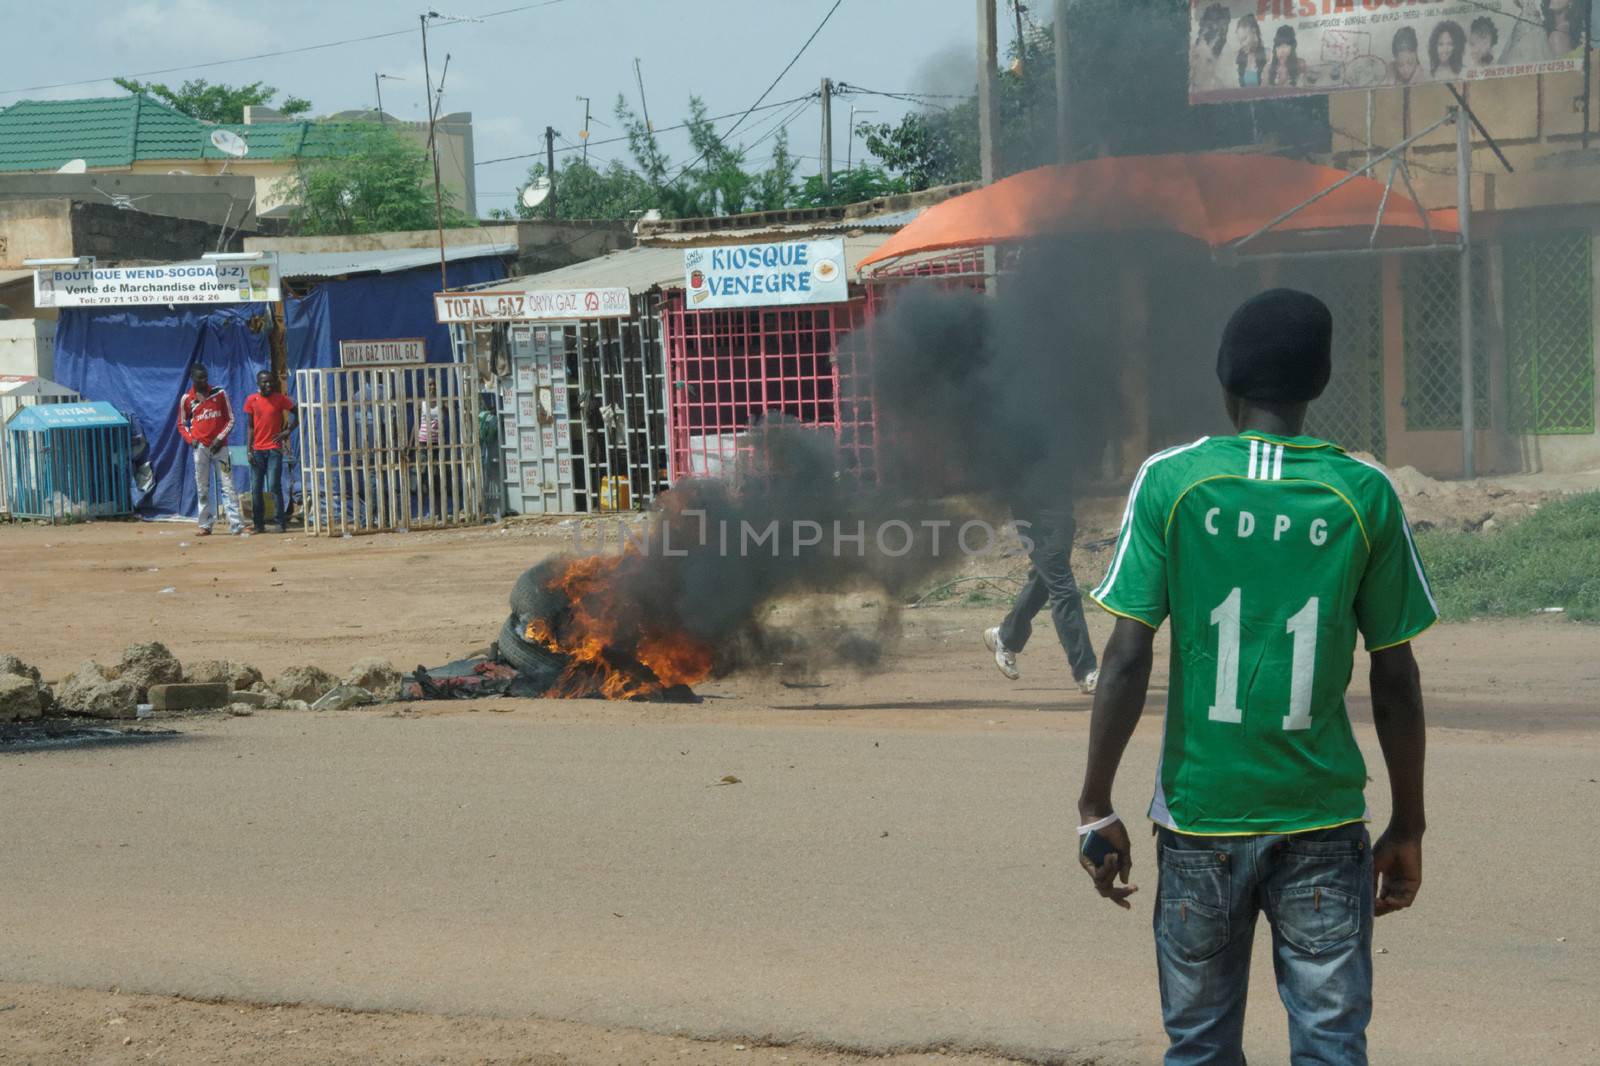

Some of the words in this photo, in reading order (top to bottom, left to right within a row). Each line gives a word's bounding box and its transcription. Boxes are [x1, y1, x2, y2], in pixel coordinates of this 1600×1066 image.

[712, 244, 808, 270] KIOSQUE
[54, 270, 121, 281] BOUTIQUE
[707, 271, 811, 296] VENEGRE
[65, 284, 98, 294] Vente
[102, 284, 116, 293] de
[120, 282, 195, 293] Marchandise
[199, 282, 236, 292] divers
[602, 291, 626, 304] ORYX
[444, 299, 490, 318] TOTAL
[497, 296, 525, 317] GAZ
[528, 295, 553, 313] ORYX
[555, 294, 577, 311] GAZ
[365, 345, 379, 361] GAZ
[382, 344, 403, 360] TOTAL
[405, 344, 419, 360] GAZ
[1208, 587, 1319, 731] 11
